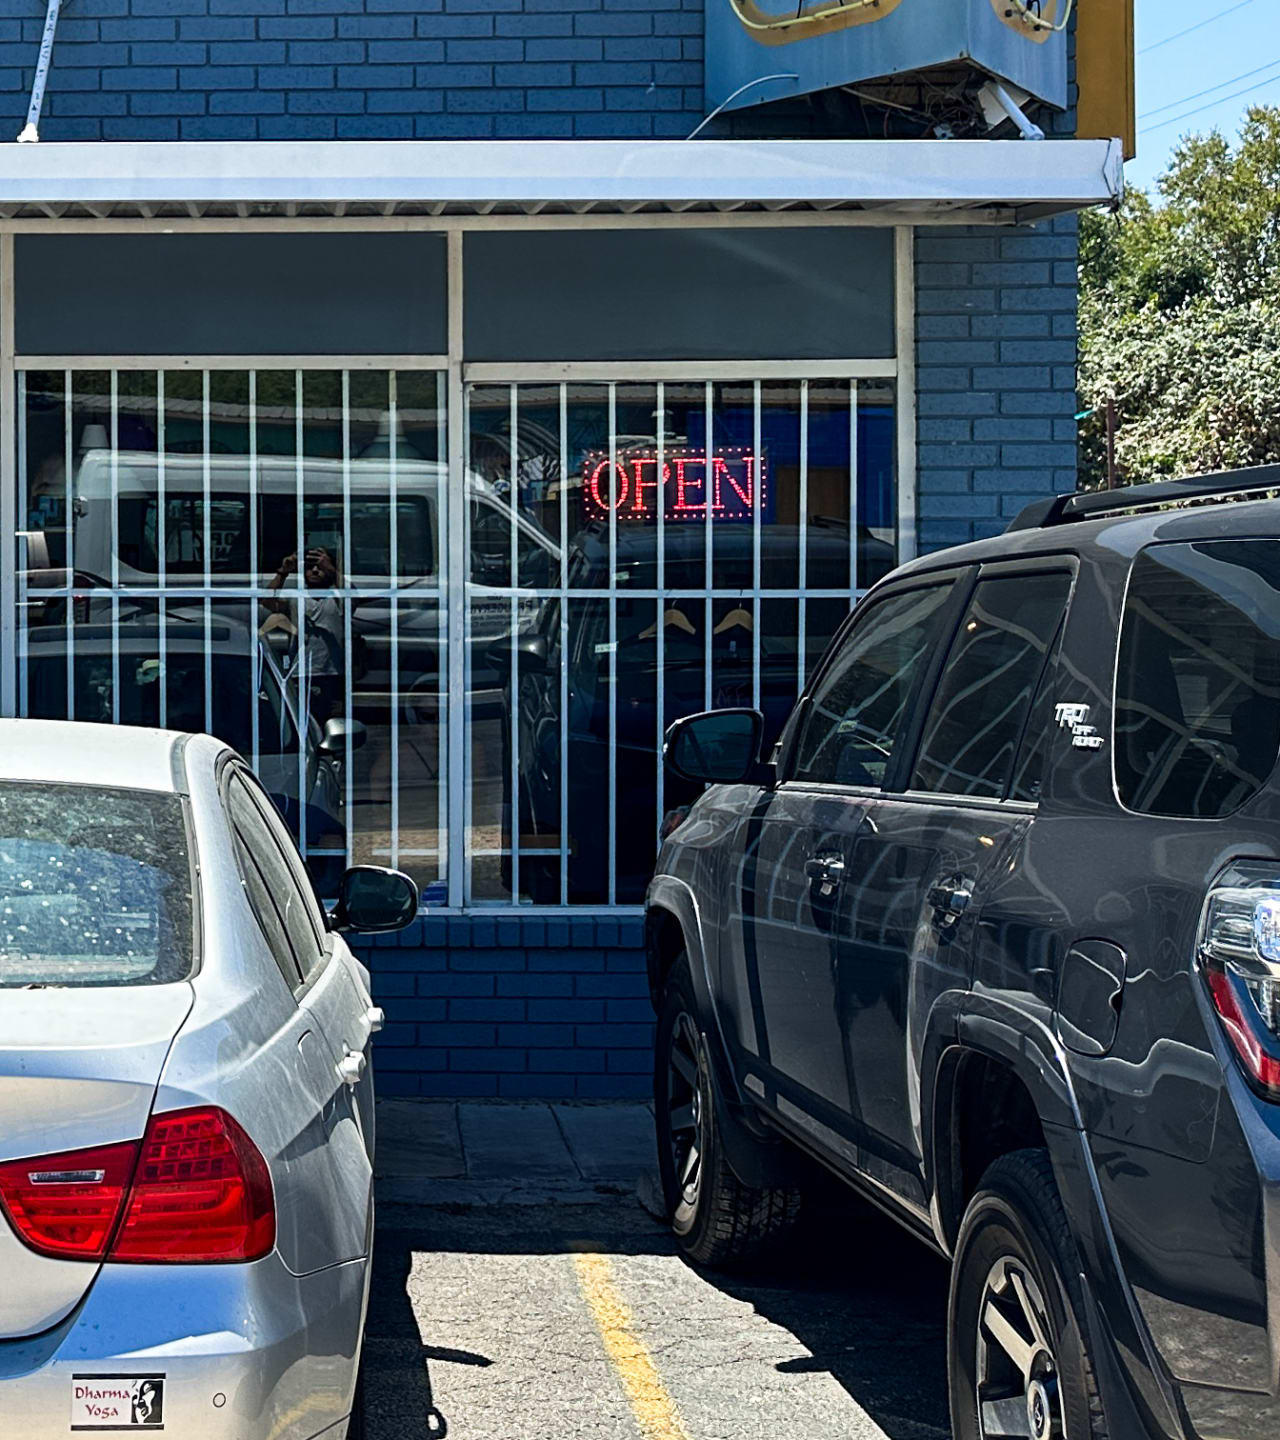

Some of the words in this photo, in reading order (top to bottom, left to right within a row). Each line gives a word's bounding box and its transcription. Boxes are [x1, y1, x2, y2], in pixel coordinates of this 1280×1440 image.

[591, 456, 760, 510] OPEN
[74, 1386, 131, 1400] Dharma
[85, 1403, 119, 1419] Yoga
